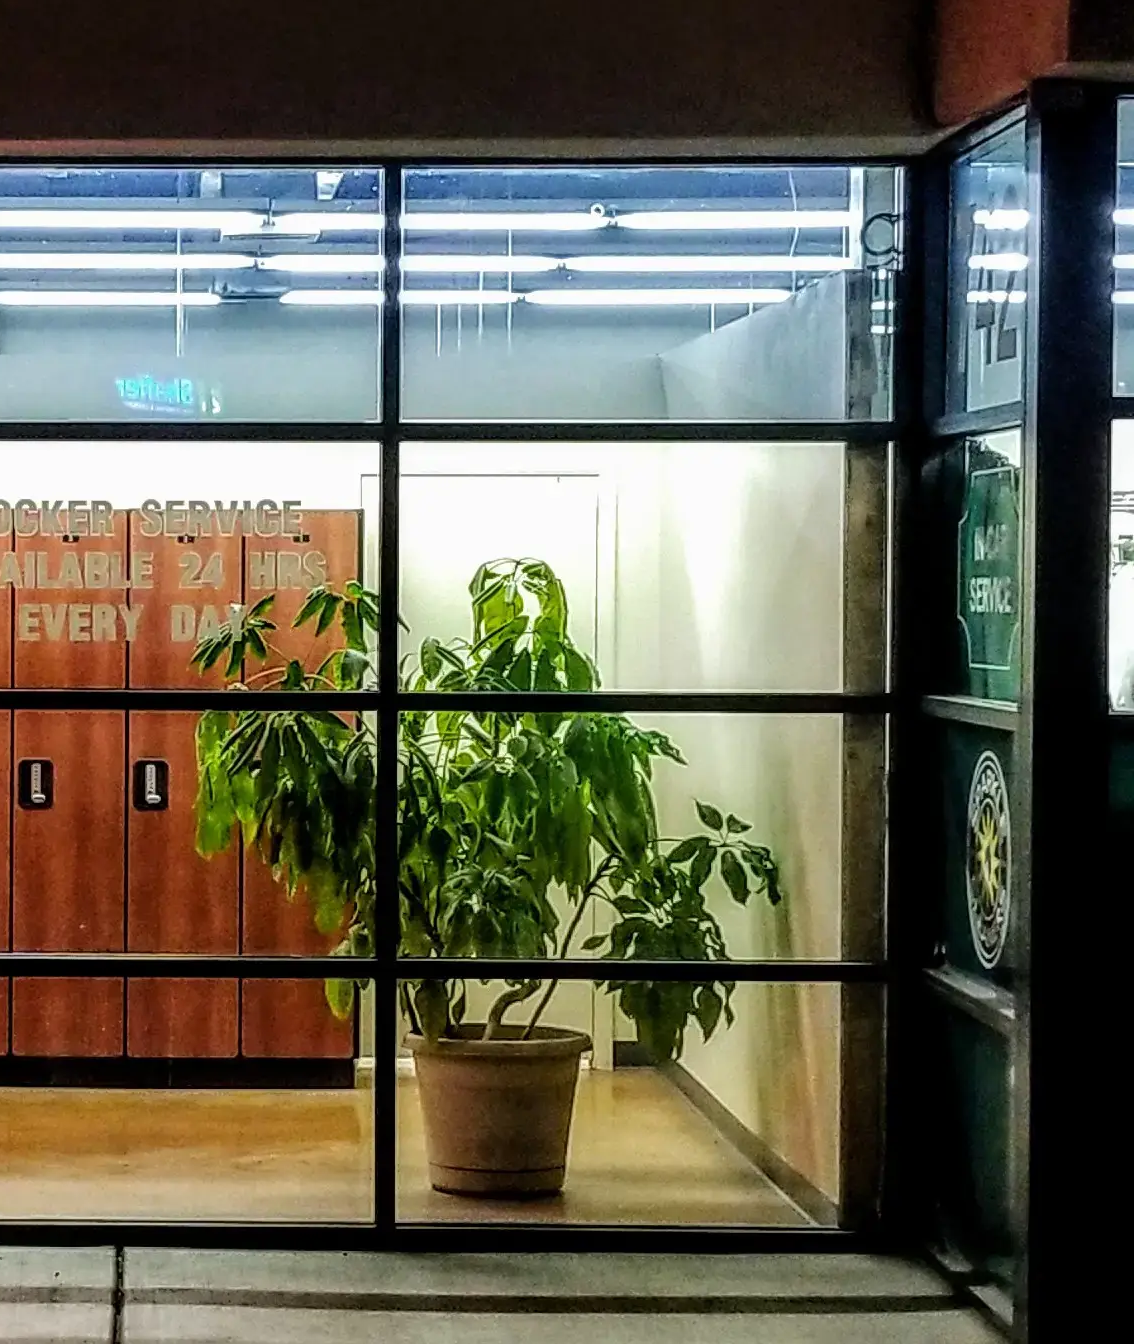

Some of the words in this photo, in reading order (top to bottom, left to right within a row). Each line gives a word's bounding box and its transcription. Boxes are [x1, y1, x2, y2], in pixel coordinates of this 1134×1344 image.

[140, 499, 303, 537] SERVICE
[178, 551, 226, 589] 24
[17, 603, 144, 642] EVERY
[171, 603, 247, 642] DAY
